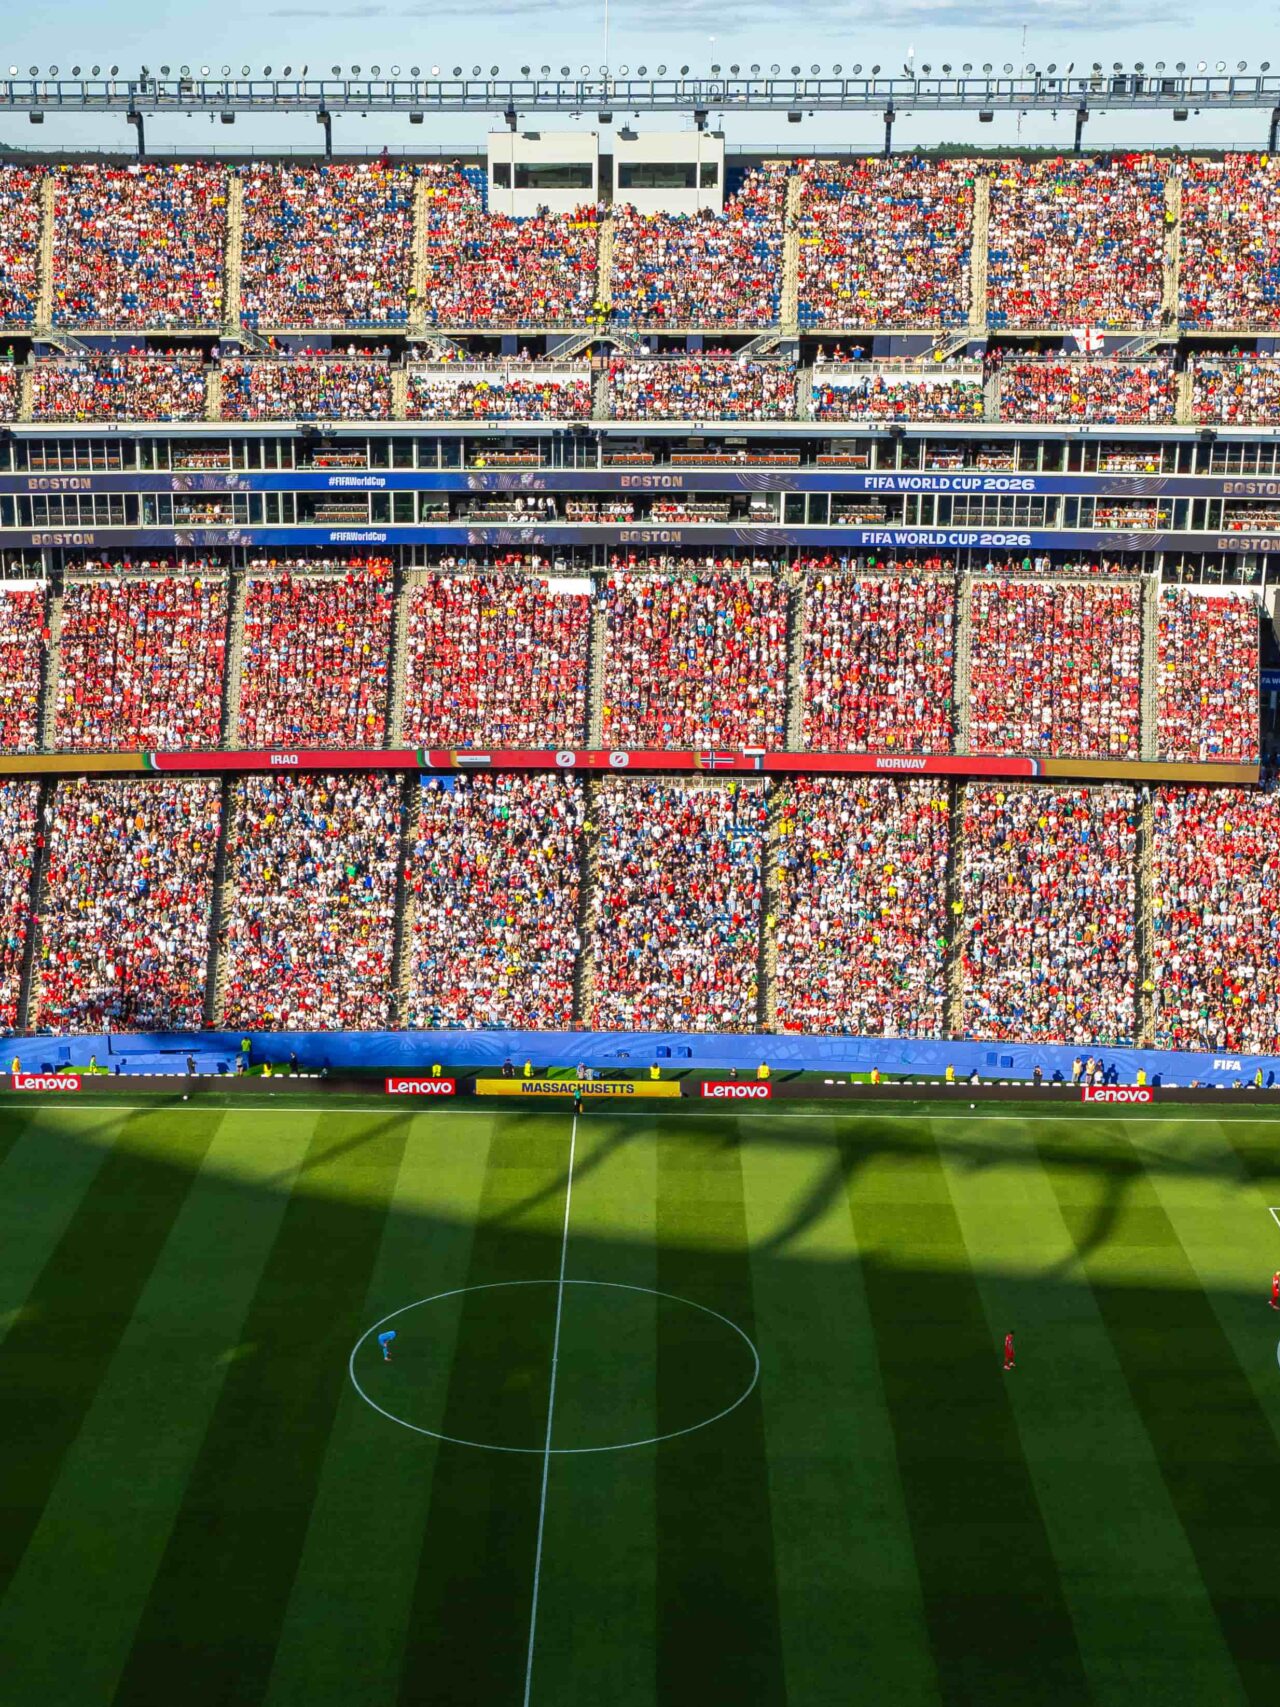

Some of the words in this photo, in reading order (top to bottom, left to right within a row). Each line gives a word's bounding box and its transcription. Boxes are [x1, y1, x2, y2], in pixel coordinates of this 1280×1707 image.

[28, 478, 91, 489] BOSTON
[328, 476, 386, 487] #FIFAWorldCup
[620, 475, 683, 487] BOSTON
[864, 477, 895, 488] FIFA
[897, 477, 949, 489] WORLD
[952, 478, 982, 489] CUP
[983, 478, 1035, 490] 2026
[31, 533, 94, 545] BOSTON
[329, 531, 387, 542] #FIFAWorldCup
[620, 531, 682, 543] BOSTON
[861, 533, 892, 543] FIFA
[894, 533, 946, 545] WORLD
[948, 534, 978, 545] CUP
[979, 534, 1031, 546] 2026
[270, 754, 299, 765] IRAQ
[876, 757, 927, 769] NORWAY
[1213, 1059, 1242, 1071] FIFA
[14, 1076, 79, 1090] Lenovo
[388, 1080, 453, 1094] Lenovo
[521, 1082, 634, 1094] MASSACHUSETTS
[703, 1083, 769, 1098] Lenovo
[1084, 1087, 1150, 1102] Lenovo
